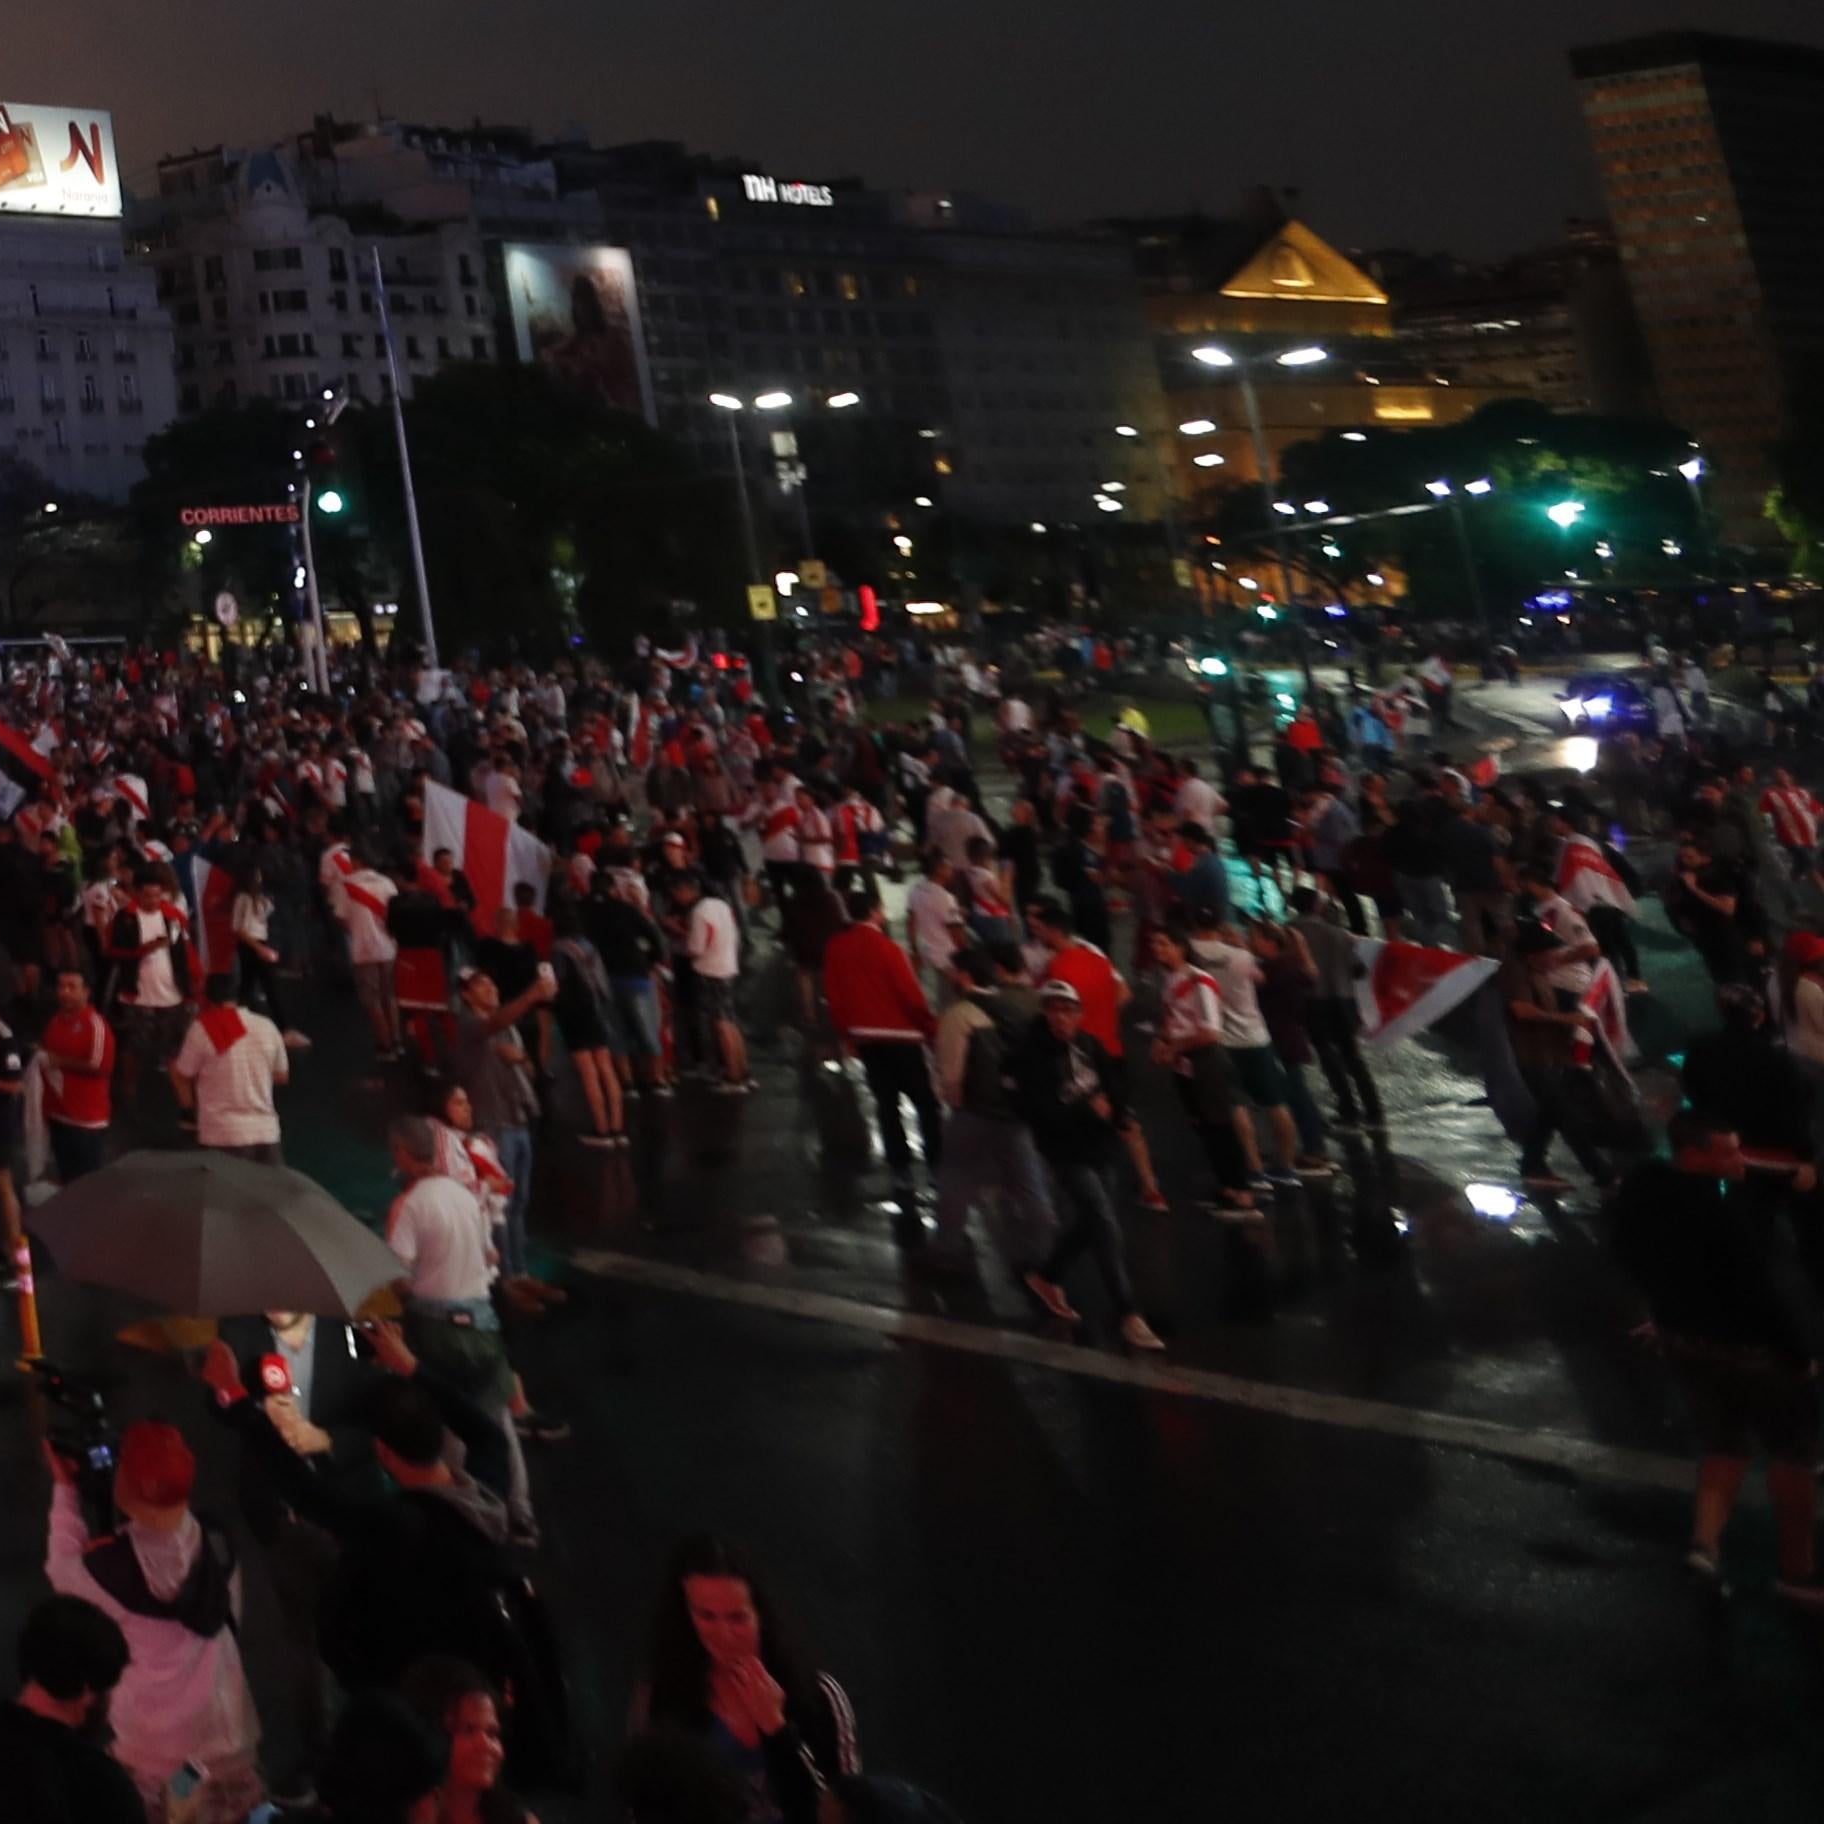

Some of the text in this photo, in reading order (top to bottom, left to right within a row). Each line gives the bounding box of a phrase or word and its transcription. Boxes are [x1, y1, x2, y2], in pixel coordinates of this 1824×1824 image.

[61, 188, 109, 205] Naranja
[778, 183, 834, 206] HOTELS
[181, 505, 300, 525] CORRIENTES
